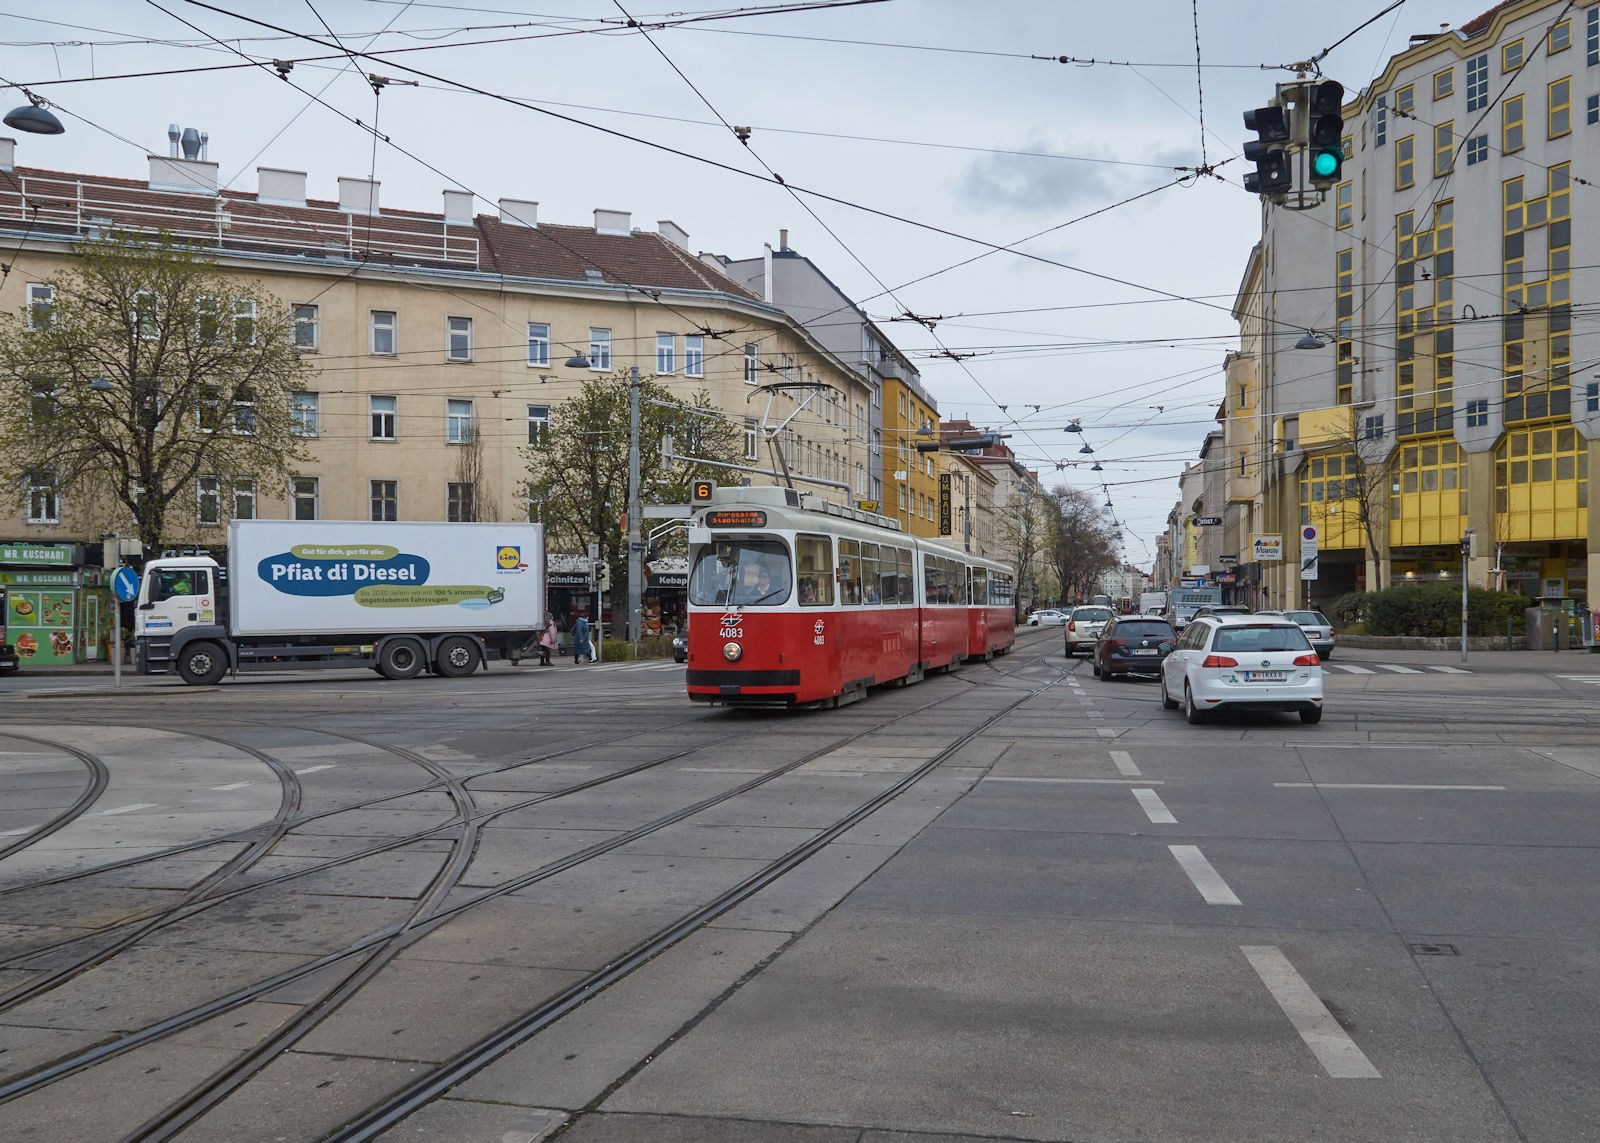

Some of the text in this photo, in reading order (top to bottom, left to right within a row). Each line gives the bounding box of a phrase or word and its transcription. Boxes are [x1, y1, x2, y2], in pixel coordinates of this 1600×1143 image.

[698, 485, 708, 497] 6
[4, 549, 65, 560] MR. KUSCHARI
[328, 548, 345, 556] dich,
[346, 548, 358, 557] gut
[271, 563, 417, 581] Pfiat di Diesel
[659, 576, 688, 585] Kebap
[454, 588, 485, 596] alternativ
[410, 596, 449, 604] Fahrzeugen
[720, 627, 743, 638] 4083
